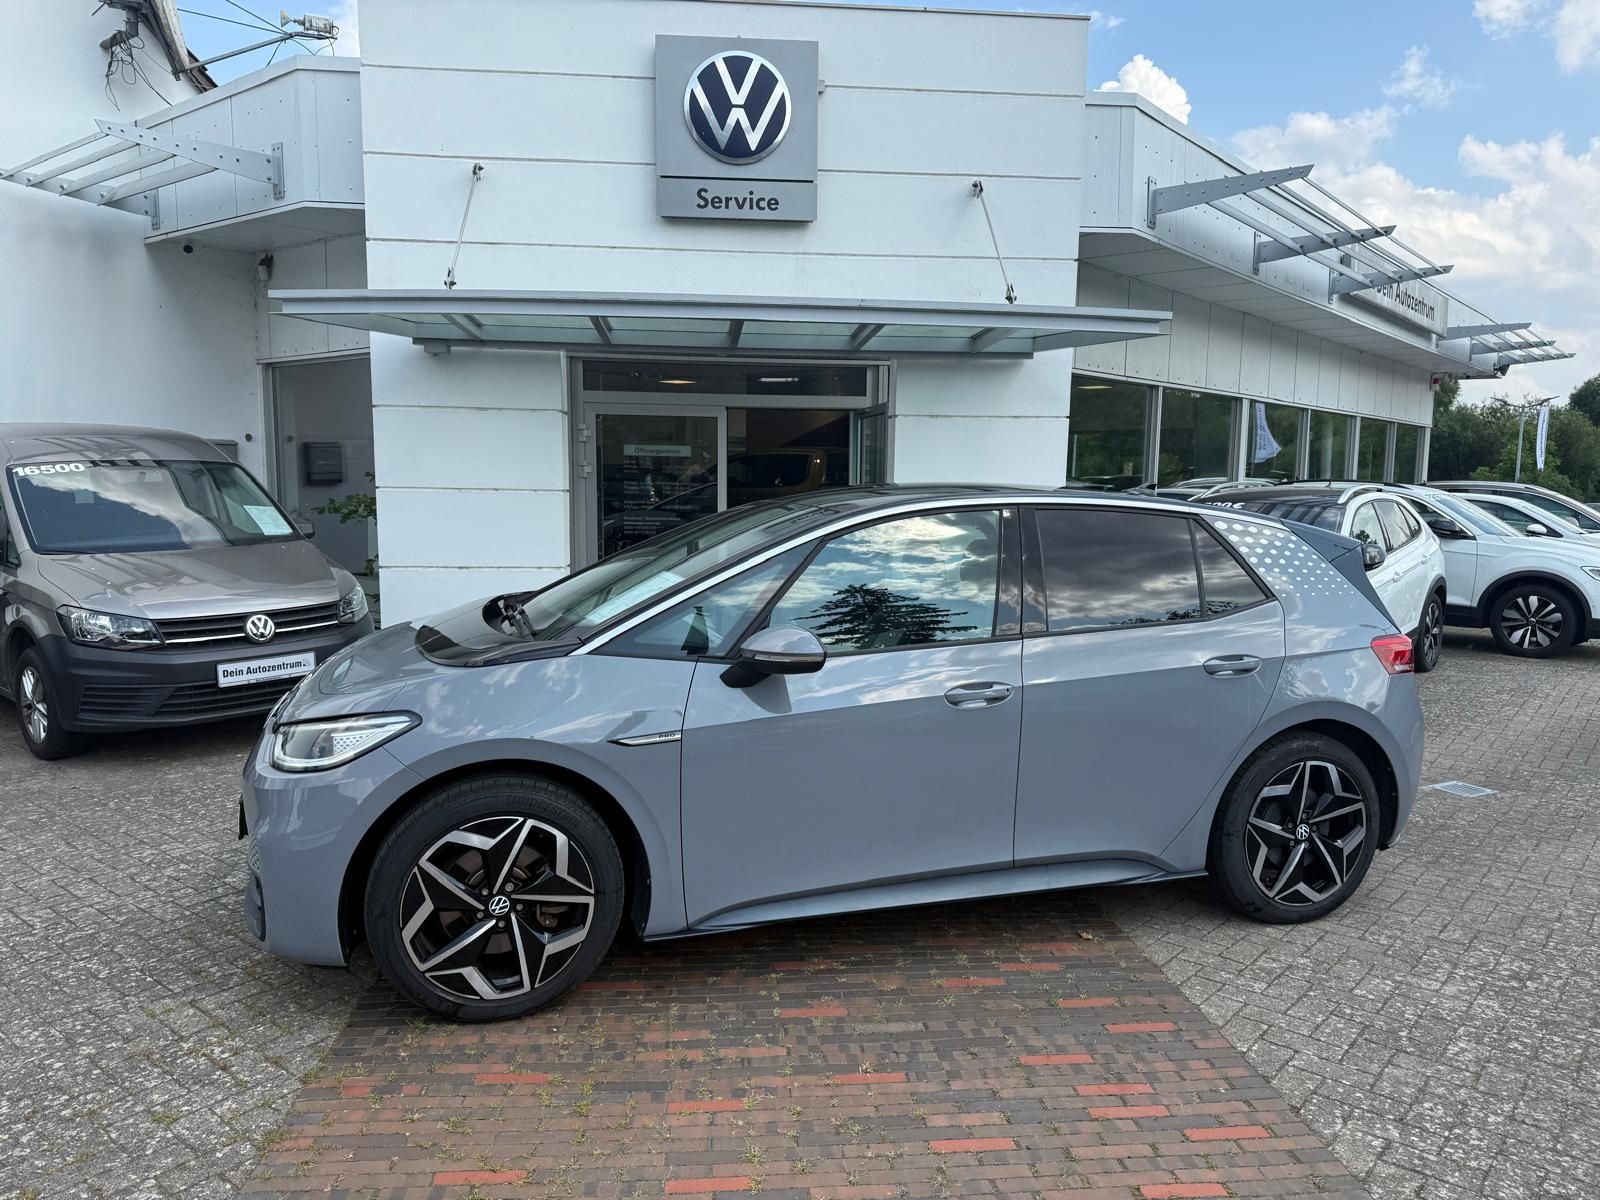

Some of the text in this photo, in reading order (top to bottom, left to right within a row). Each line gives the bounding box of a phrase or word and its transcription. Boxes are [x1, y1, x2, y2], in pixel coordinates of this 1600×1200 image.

[696, 187, 780, 211] Service
[1395, 280, 1435, 320] Autozentrum
[12, 463, 85, 476] 16500
[222, 668, 244, 679] Dein
